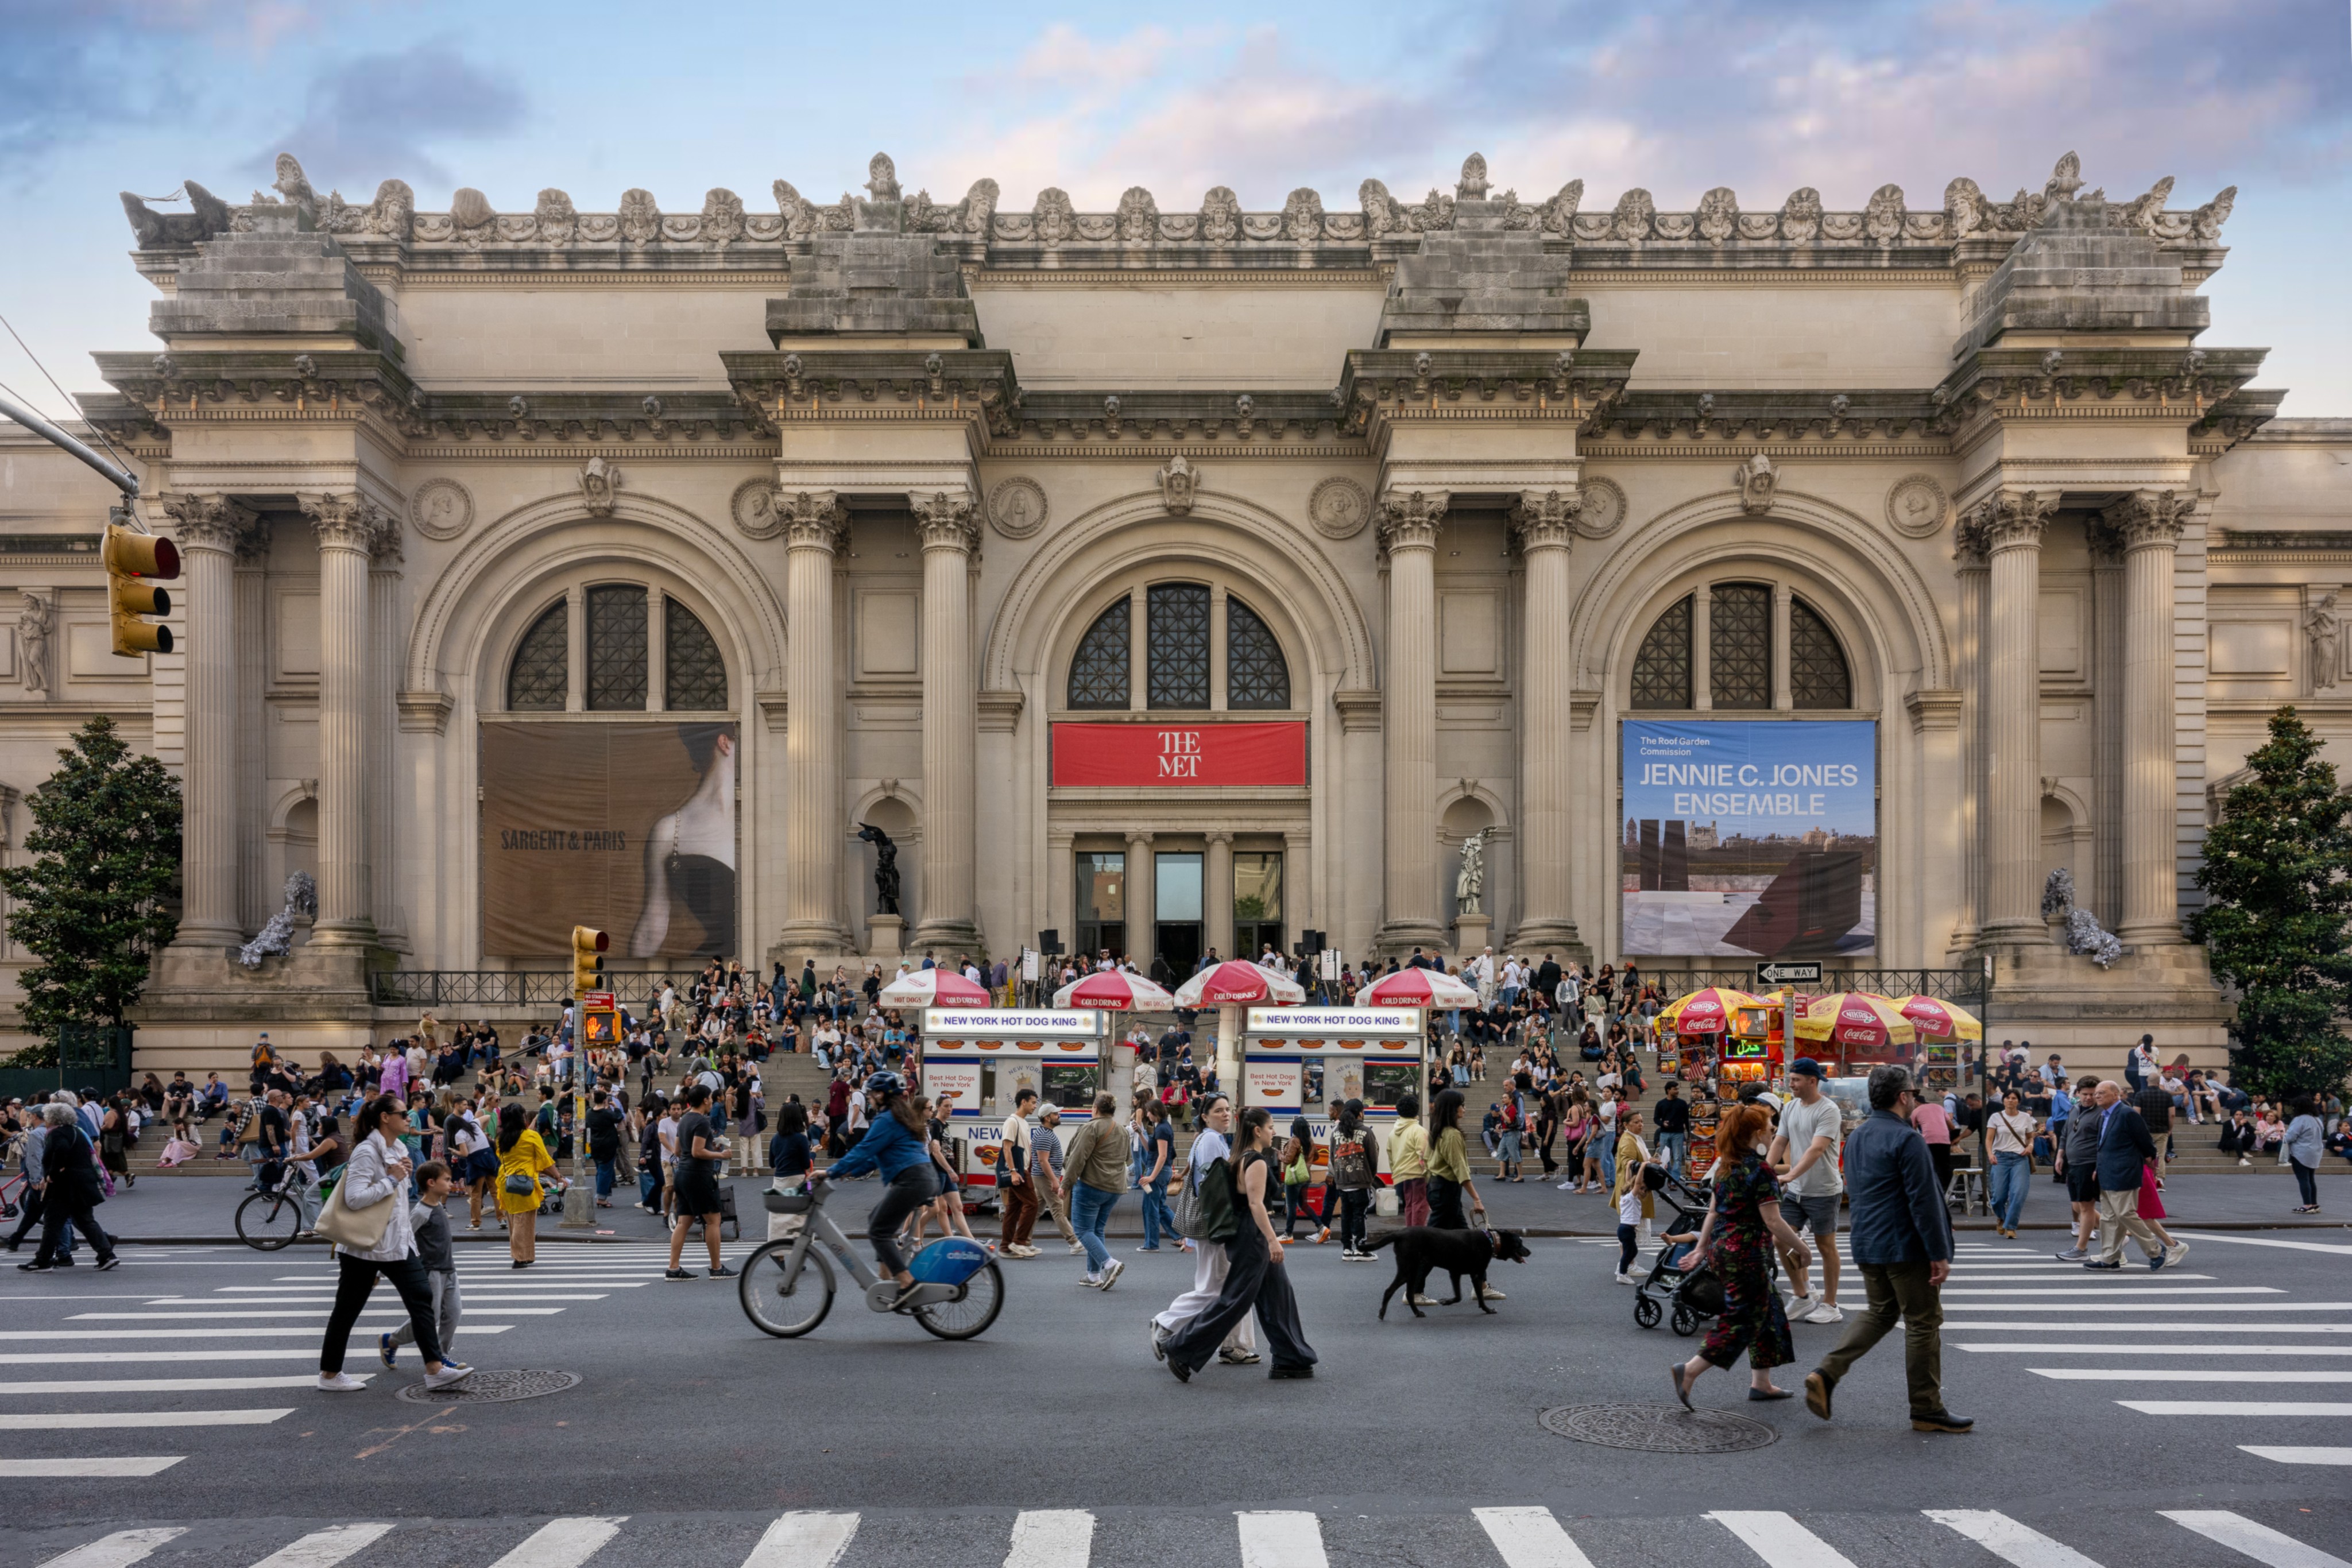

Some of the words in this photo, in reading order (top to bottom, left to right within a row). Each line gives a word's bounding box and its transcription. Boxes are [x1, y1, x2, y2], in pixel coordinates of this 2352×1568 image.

[1158, 731, 1201, 753] THE
[1641, 737, 1657, 745] The
[1658, 737, 1678, 745] Roof
[1679, 737, 1710, 746] Garden
[1640, 748, 1691, 756] Commission
[1157, 756, 1202, 777] MET
[1639, 764, 1733, 786] JENNIE
[1738, 764, 1765, 787] C.
[1769, 764, 1858, 787] JONES
[1674, 793, 1825, 815] ENSEMBLE
[501, 830, 567, 850] SARGENT
[568, 831, 581, 850] &
[583, 830, 625, 850] PARIS
[1767, 969, 1785, 977] ONE
[1794, 969, 1813, 977] WAY
[1232, 990, 1257, 999] DRINKS
[1081, 998, 1098, 1006] COLD
[1098, 998, 1121, 1006] DRINKS
[1846, 1011, 1867, 1019] NIKAS
[944, 1017, 967, 1025] NEW
[970, 1017, 998, 1025] YORK
[1001, 1017, 1022, 1025] HOT
[1026, 1017, 1049, 1026] DOG
[1052, 1017, 1077, 1026] KING
[1267, 1016, 1290, 1024] NEW
[1293, 1016, 1321, 1024] YORK
[1324, 1016, 1345, 1024] HOT
[1349, 1016, 1371, 1024] DOG
[1375, 1016, 1400, 1025] KING
[1008, 1065, 1023, 1075] NEW
[1025, 1065, 1042, 1075] YORK
[1336, 1063, 1351, 1074] NEW
[968, 1127, 1002, 1140] NEW
